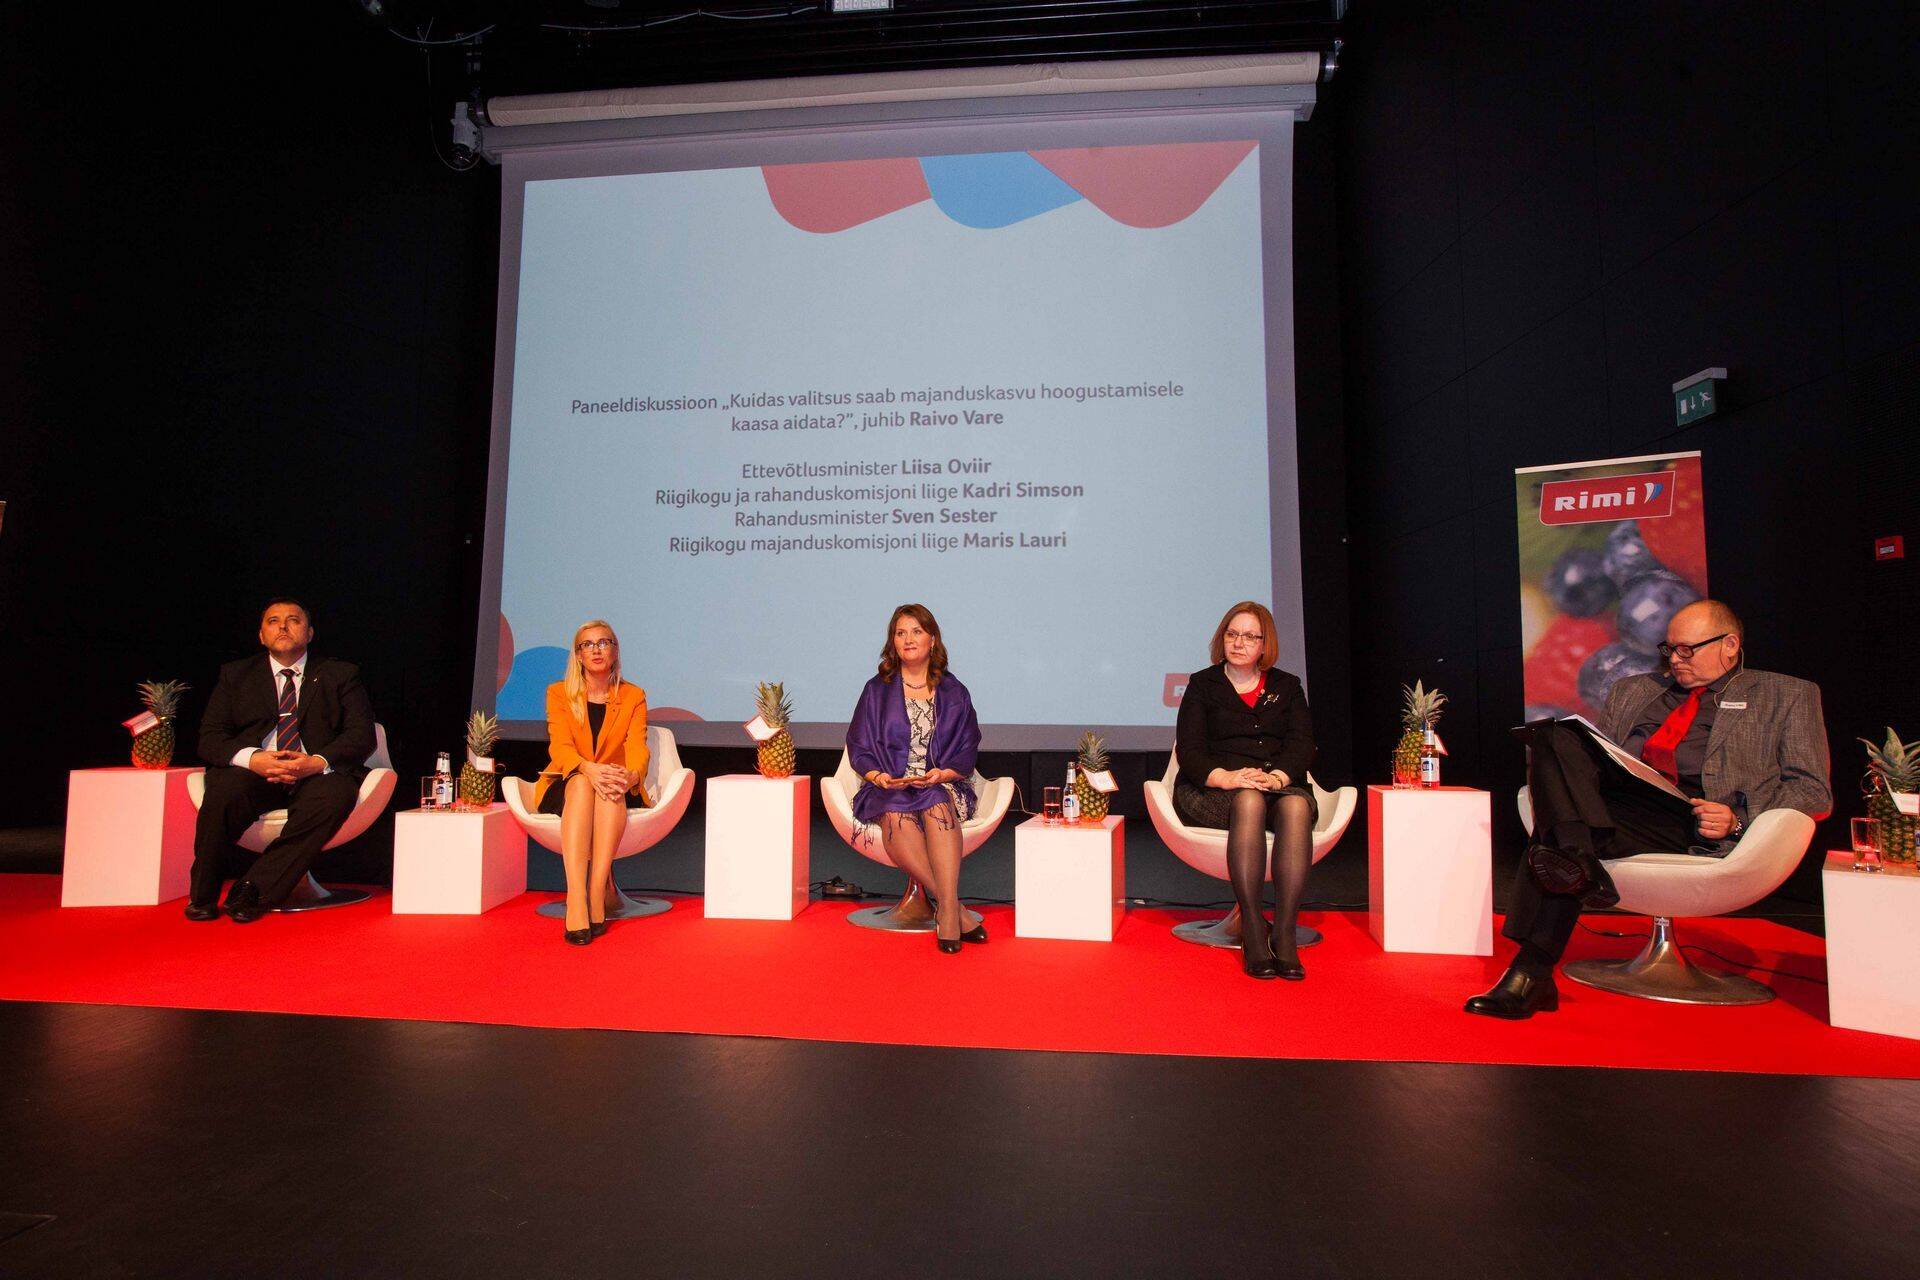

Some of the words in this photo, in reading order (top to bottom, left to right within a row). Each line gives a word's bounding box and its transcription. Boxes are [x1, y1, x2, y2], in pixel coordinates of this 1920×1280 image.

[571, 395, 718, 414] Paneeldiskussioon
[787, 389, 852, 407] valitsus
[855, 387, 896, 405] saab
[900, 384, 1036, 407] majanduskasvu
[1040, 380, 1184, 403] hoogustamisele
[731, 416, 780, 432] kaasa
[860, 410, 906, 431] juhib
[909, 410, 959, 427] Raivo
[962, 409, 1004, 426] Vare
[742, 460, 899, 479] Ettevõtlusminister
[901, 458, 943, 475] Liisa
[947, 457, 993, 475] Oviir
[655, 488, 732, 509] Riigikogu
[733, 488, 750, 507] ja
[754, 483, 917, 505] rahanduskomisjoni
[921, 482, 959, 503] liige
[962, 481, 1011, 499] Kadri
[1015, 481, 1084, 498] Simson
[734, 510, 890, 528] Rahandusminister
[891, 508, 935, 525] Sven
[939, 507, 998, 524] Sester
[669, 535, 746, 557] Riigikogu
[750, 532, 918, 556] majanduskomisjoni
[921, 532, 959, 554] liige
[962, 531, 1015, 549] Maris
[1019, 531, 1068, 548] Lauri
